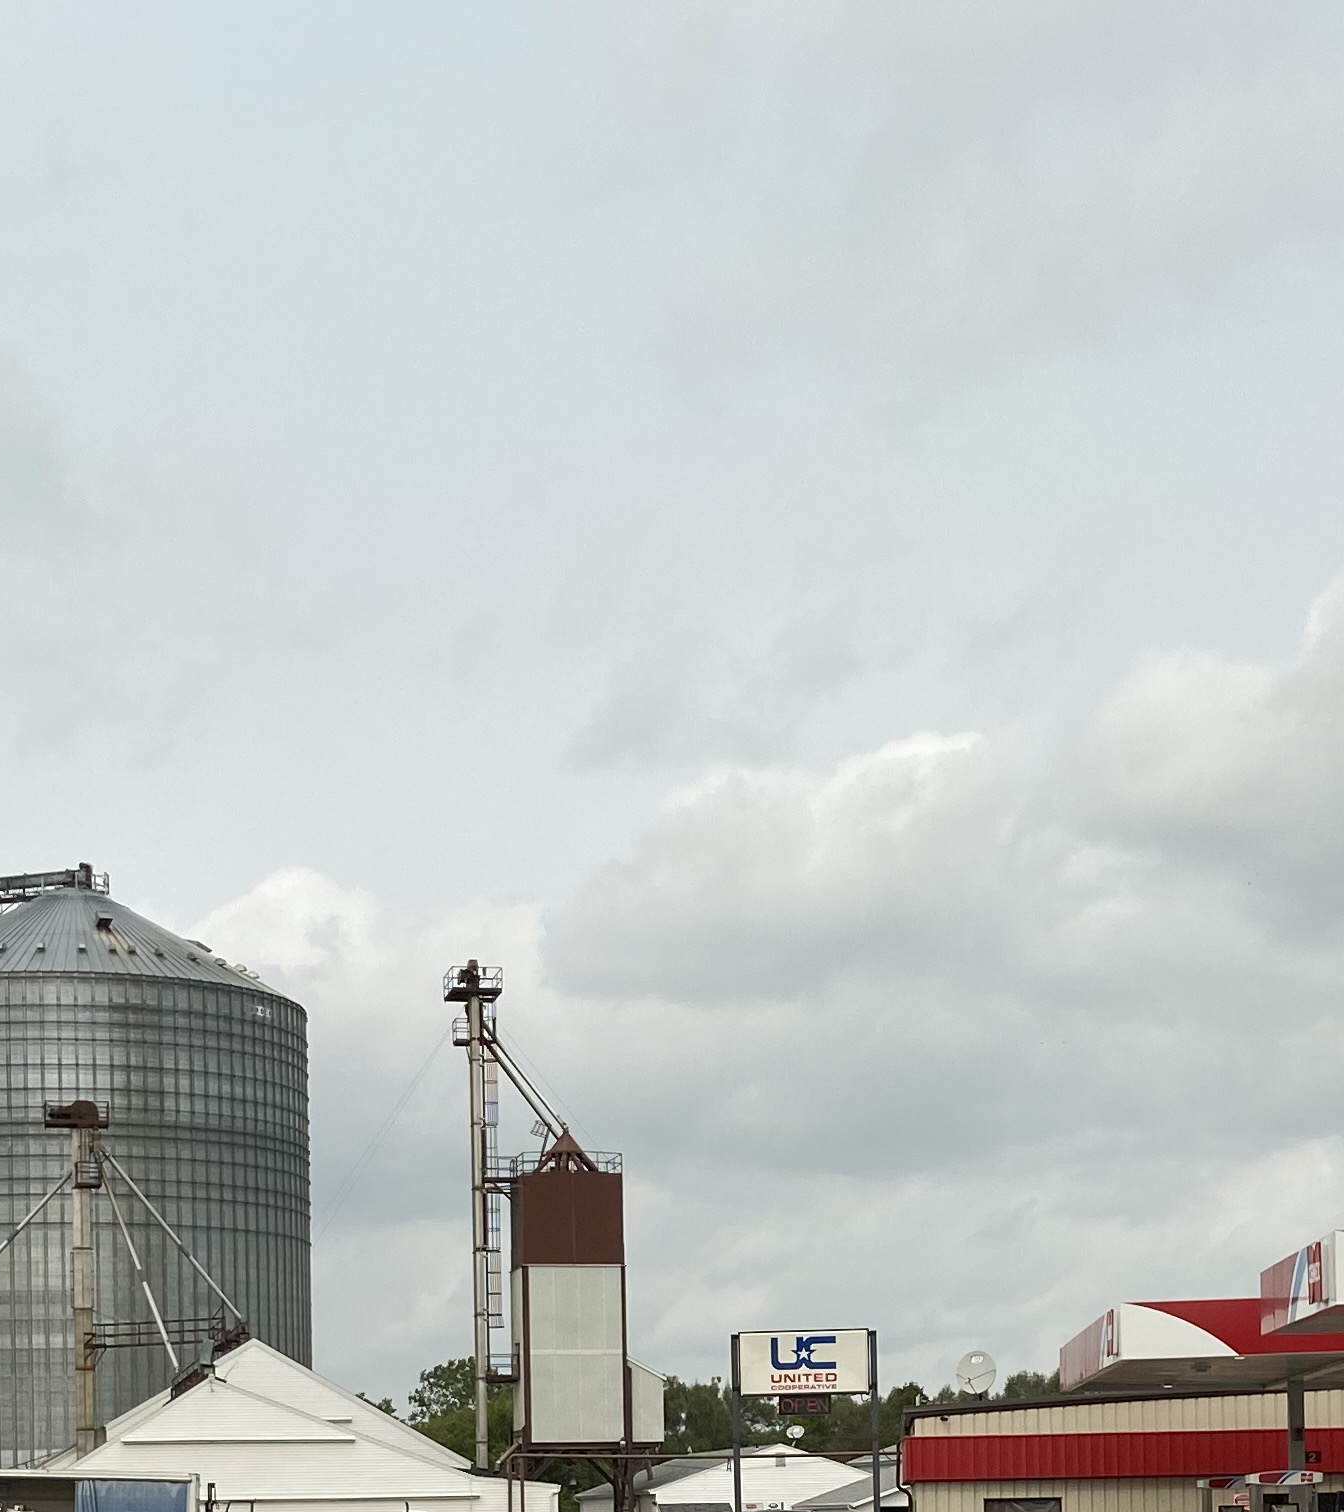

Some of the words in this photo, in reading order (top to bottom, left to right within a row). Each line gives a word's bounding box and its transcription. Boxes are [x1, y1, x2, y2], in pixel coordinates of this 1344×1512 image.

[770, 1336, 837, 1370] UC
[771, 1373, 837, 1384] UNITED
[771, 1383, 837, 1391] COOPERATIVE
[780, 1397, 830, 1414] OPEN
[1308, 1453, 1317, 1463] 2
